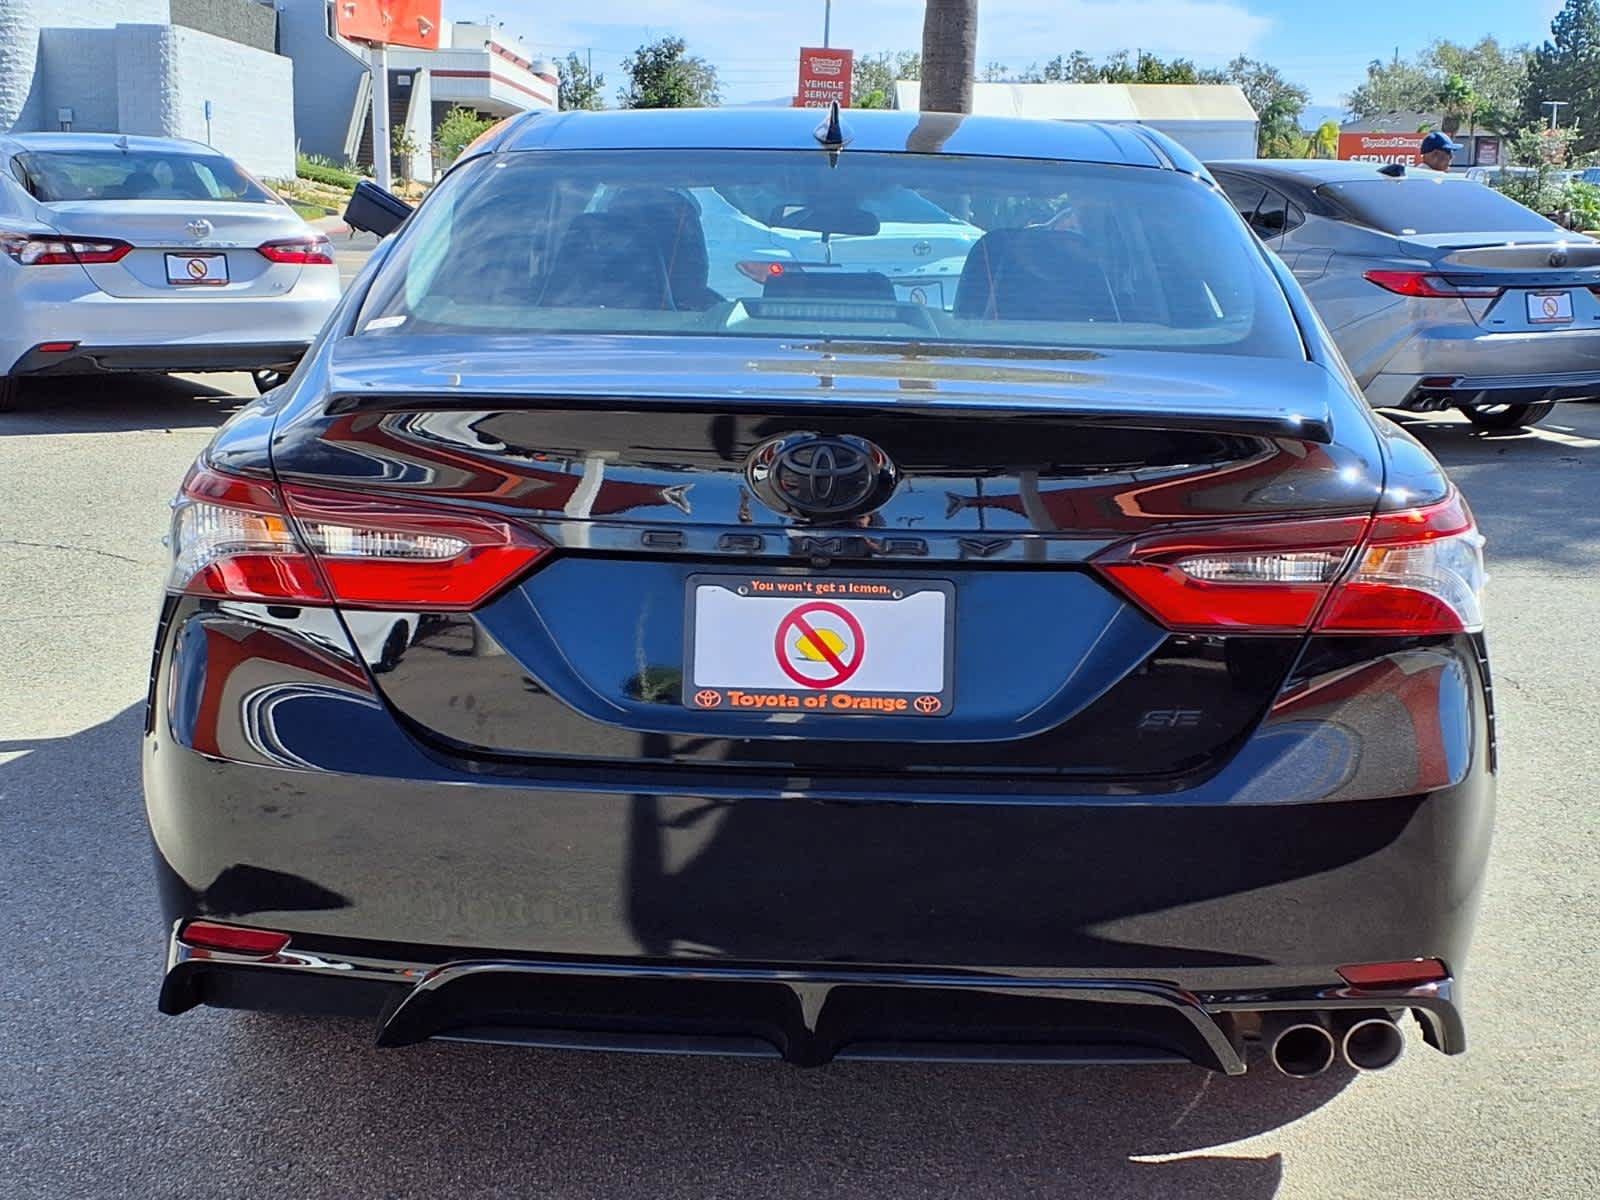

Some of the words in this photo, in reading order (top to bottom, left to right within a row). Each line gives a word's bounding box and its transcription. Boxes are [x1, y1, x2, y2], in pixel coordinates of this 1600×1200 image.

[804, 79, 844, 89] VEHICLE
[804, 89, 844, 100] SERVICE
[804, 100, 842, 108] CENT
[1350, 154, 1416, 166] SERVICE
[641, 530, 1014, 558] CAMRY
[751, 580, 774, 591] You
[777, 582, 813, 592] won't
[815, 583, 836, 594] get
[838, 585, 847, 593] a
[849, 583, 891, 594] lemon.
[728, 691, 799, 708] Toyota
[804, 694, 827, 708] of
[831, 694, 908, 711] Orange
[1138, 710, 1202, 728] SE
